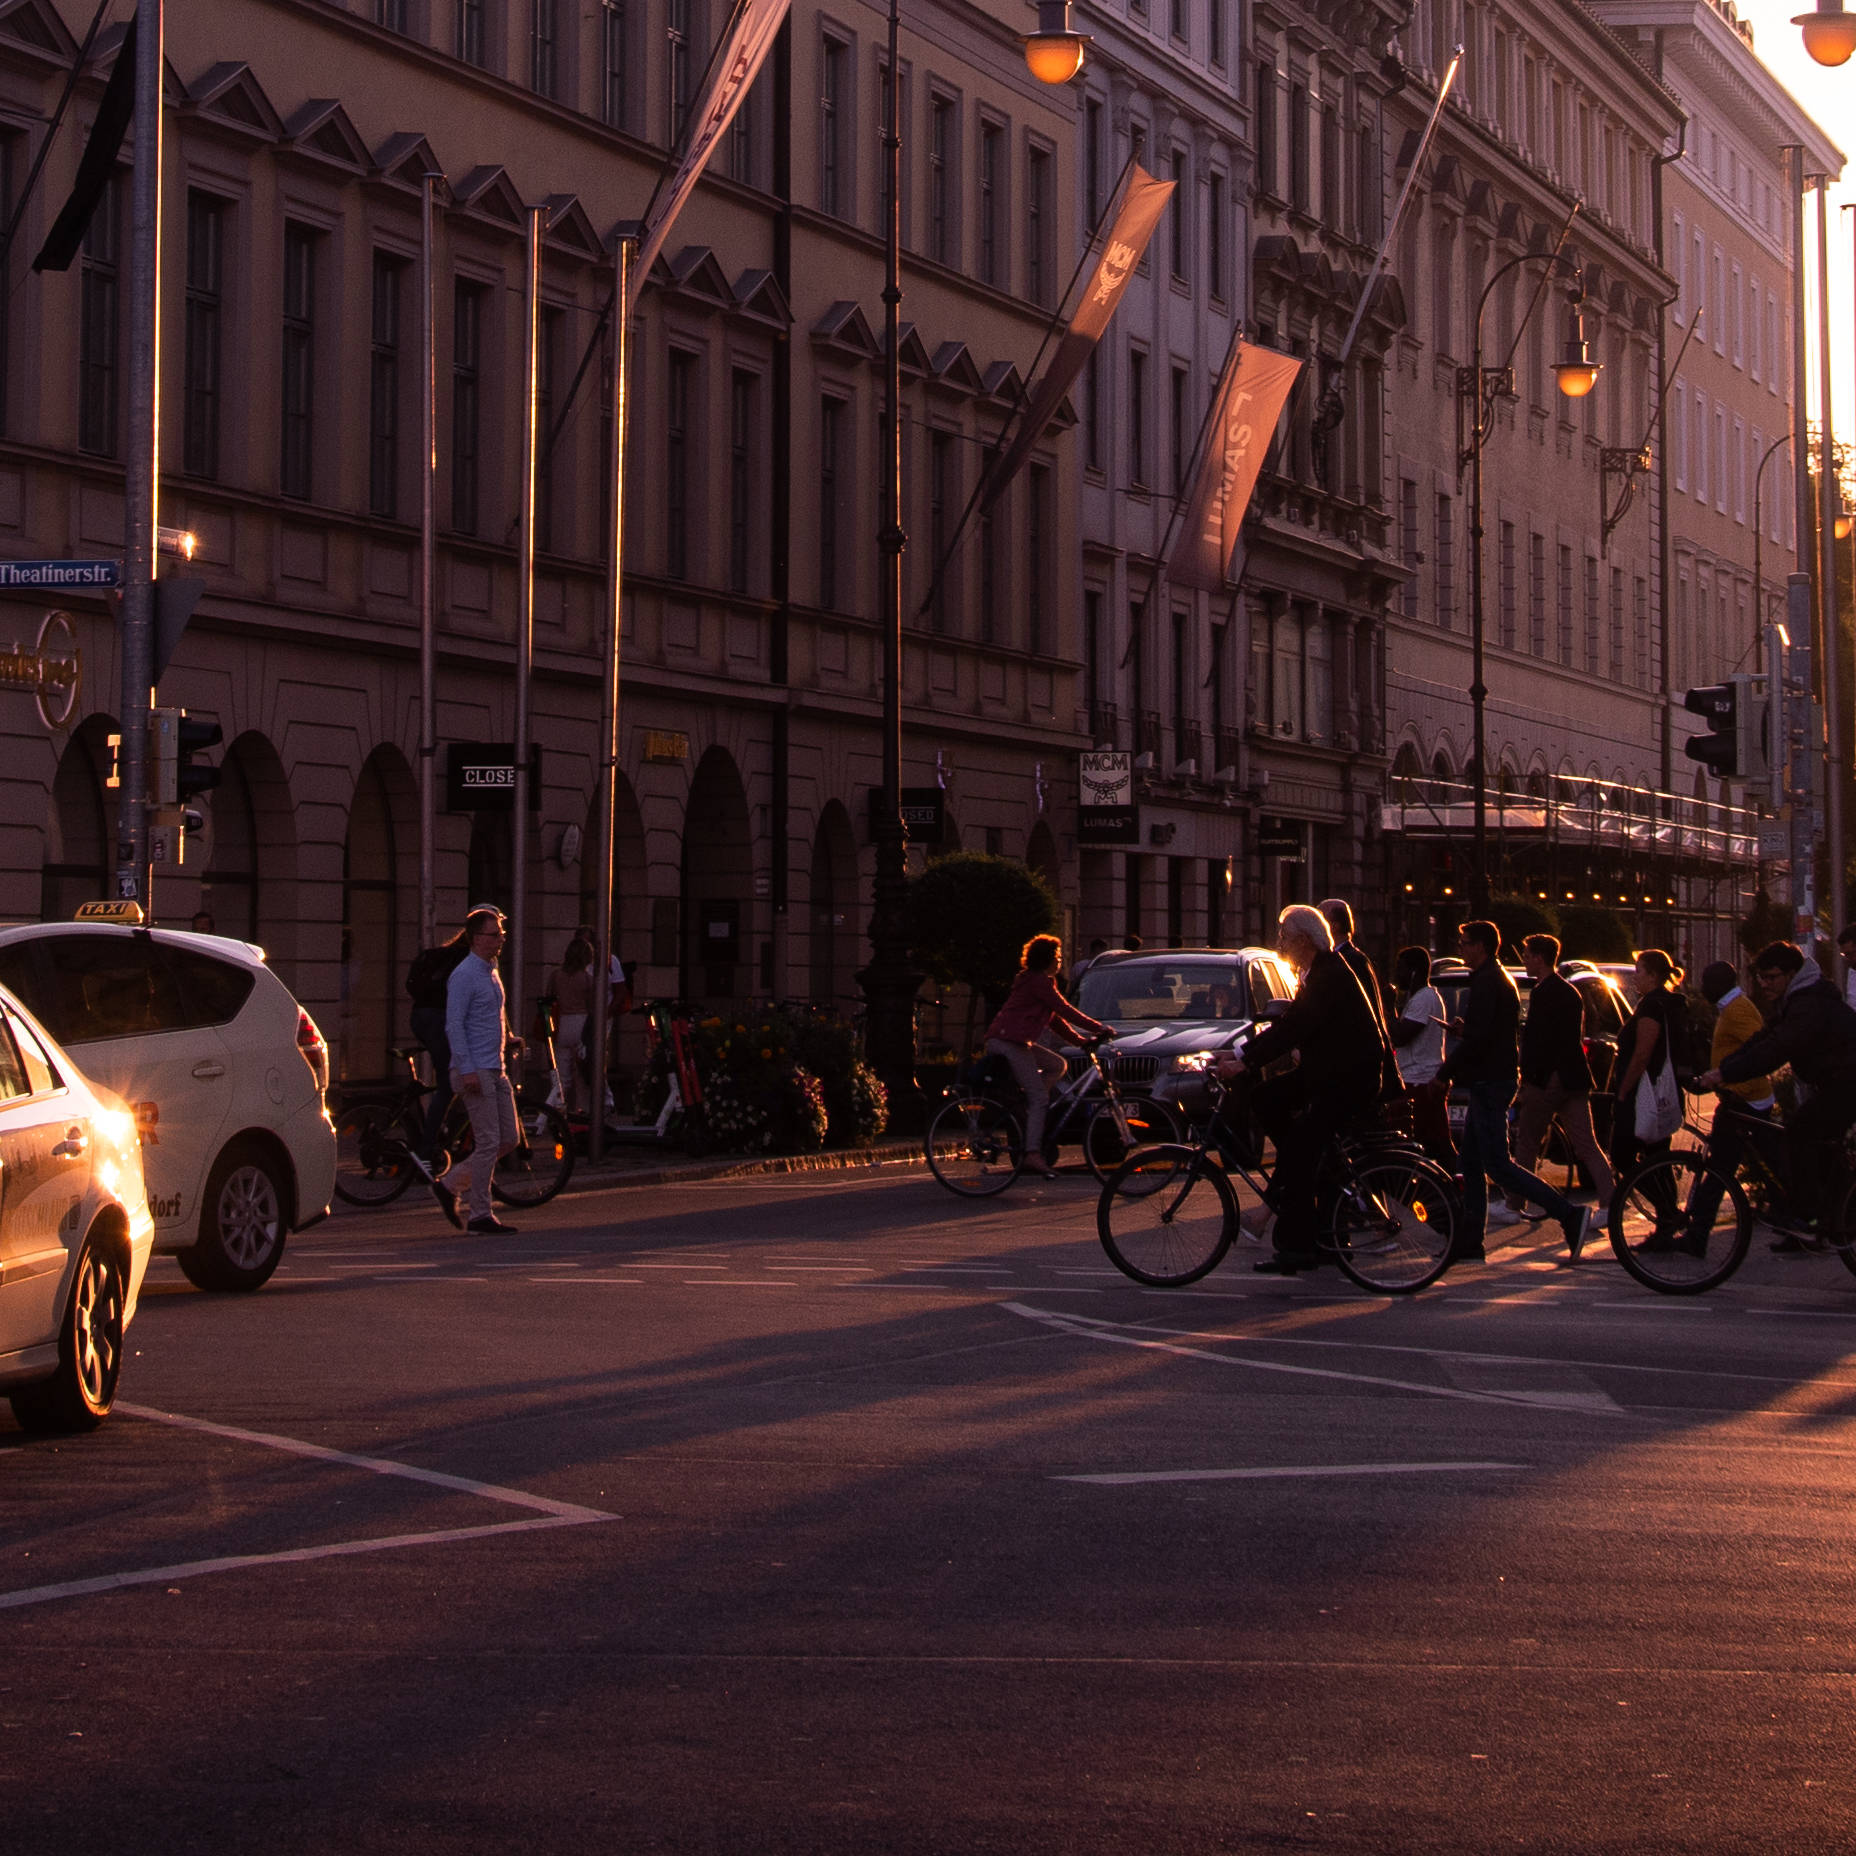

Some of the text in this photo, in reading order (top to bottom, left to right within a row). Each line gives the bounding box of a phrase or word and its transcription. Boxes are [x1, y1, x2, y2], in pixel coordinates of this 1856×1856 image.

[1082, 754, 1128, 771] MCM
[464, 769, 516, 784] CLOSE
[1083, 816, 1123, 828] LUMAS
[85, 902, 127, 915] TAXI
